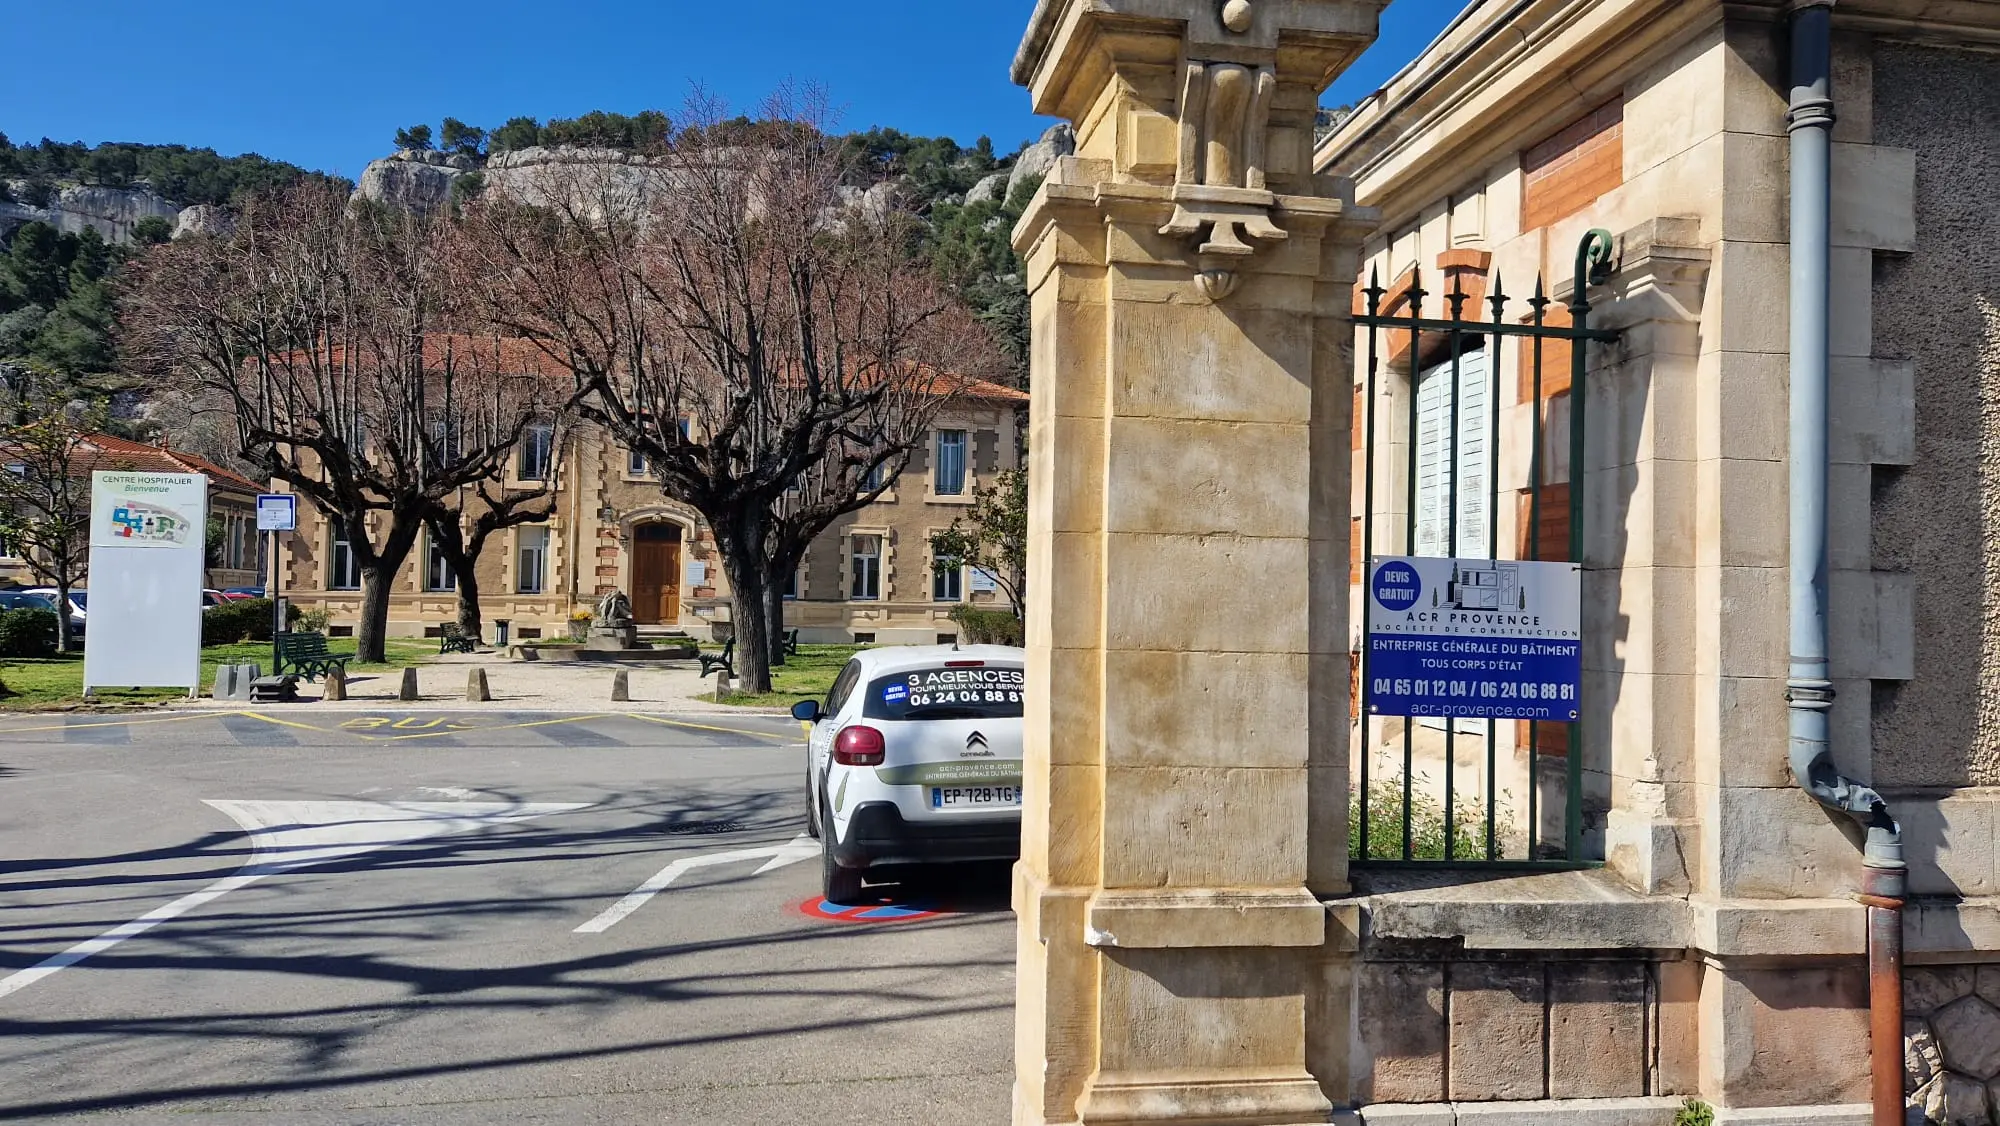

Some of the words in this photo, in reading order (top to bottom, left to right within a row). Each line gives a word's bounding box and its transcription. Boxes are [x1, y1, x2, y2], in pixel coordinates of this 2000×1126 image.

[102, 475, 136, 484] CENTRE
[137, 476, 193, 485] HOSPITALIER
[124, 484, 170, 493] Bienvenue
[1384, 570, 1410, 583] DEVIS
[1379, 587, 1415, 601] GRATUIT
[1406, 611, 1439, 622] ACR
[1450, 613, 1540, 626] PROVENCE
[1470, 627, 1578, 637] CONSTRUCTION
[1373, 639, 1439, 652] ENTREPRISE
[1442, 640, 1498, 654] GÉNÉRALE
[1501, 643, 1518, 655] DU
[1521, 642, 1577, 657] BÂTIMENT
[1421, 658, 1449, 669] TOUS
[1452, 659, 1486, 670] CORPS
[1489, 660, 1523, 671] D'ÉTAT
[908, 674, 920, 686] 3
[926, 670, 1023, 684] AGENCES
[910, 685, 936, 693] POUR
[938, 683, 966, 691] MIEUX
[968, 682, 994, 690] VOUS
[1373, 678, 1391, 695] 04
[1394, 678, 1411, 695] 65
[1414, 679, 1429, 696] 01
[1432, 680, 1447, 697] 12
[1449, 680, 1467, 697] 04
[1469, 681, 1477, 697] /
[1480, 681, 1498, 698] 06
[1500, 682, 1518, 699] 24
[1520, 682, 1538, 699] 06
[1540, 683, 1557, 700] 88
[1560, 683, 1574, 700] 81
[910, 694, 931, 706] 06
[935, 691, 956, 704] 24
[960, 690, 980, 702] 06
[985, 690, 1005, 702] 88
[1008, 691, 1024, 703] 81
[1410, 703, 1549, 719] acr-provence.com
[338, 716, 494, 729] BUS
[939, 763, 1015, 772] acr-provence.com
[943, 786, 1012, 804] EP-728-TG
